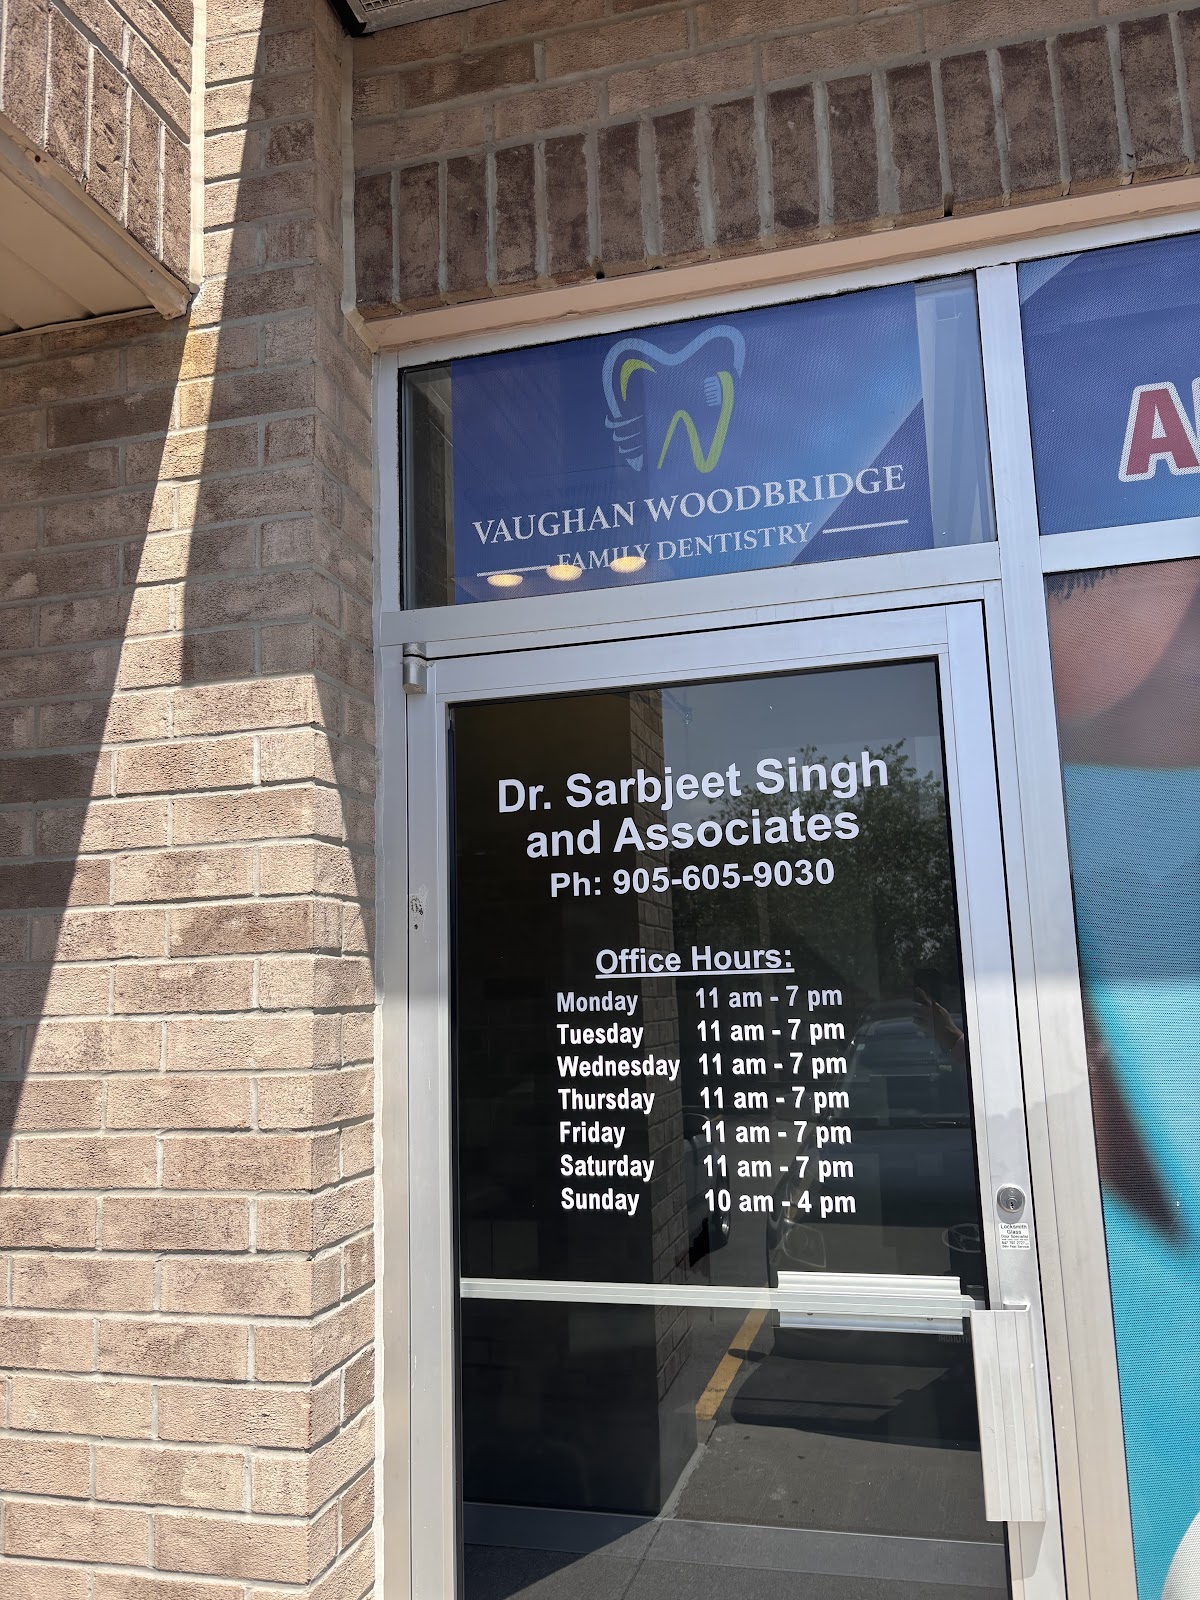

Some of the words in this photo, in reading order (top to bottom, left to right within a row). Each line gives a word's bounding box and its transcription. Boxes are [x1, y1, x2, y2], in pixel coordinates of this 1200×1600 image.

[1118, 376, 1200, 482] A
[472, 500, 635, 545] VAUGHAN
[644, 464, 906, 523] WOODBRIDGE
[556, 543, 650, 571] FAMILY
[657, 522, 813, 561] DENTISTRY
[499, 779, 550, 812] Dr.
[566, 763, 741, 810] Sarbjeet
[756, 751, 888, 798] Singh
[527, 820, 600, 858] and
[614, 807, 859, 852] Associates
[551, 872, 600, 897] Ph:
[613, 859, 834, 894] 905-605-9030
[596, 948, 682, 974] Office
[692, 946, 792, 971] Hours:
[557, 991, 638, 1016] Monday
[696, 987, 718, 1008] 11
[729, 992, 762, 1007] am
[786, 986, 798, 1006] 7
[808, 990, 842, 1011] pm
[557, 1023, 643, 1048] Tuesday
[698, 1020, 720, 1041] 11
[731, 1025, 764, 1041] am
[788, 1019, 801, 1040] 7
[810, 1023, 844, 1045] pm
[557, 1054, 680, 1081] Wednesday
[699, 1053, 721, 1074] 11
[732, 1058, 766, 1074] am
[790, 1052, 803, 1074] 7
[812, 1057, 847, 1079] pm
[558, 1088, 655, 1114] Thursday
[701, 1087, 723, 1108] 11
[734, 1092, 768, 1108] am
[792, 1087, 805, 1108] 7
[814, 1091, 849, 1113] pm
[560, 1121, 625, 1148] Friday
[702, 1121, 725, 1142] 11
[736, 1126, 770, 1143] am
[794, 1121, 807, 1142] 7
[816, 1126, 851, 1148] pm
[561, 1154, 654, 1182] Saturday
[704, 1155, 726, 1176] 11
[738, 1160, 771, 1177] am
[796, 1156, 809, 1178] 7
[819, 1160, 853, 1182] pm
[561, 1188, 639, 1215] Sunday
[705, 1189, 731, 1211] 10
[739, 1195, 773, 1212] am
[797, 1190, 812, 1212] 4
[820, 1196, 856, 1218] pm
